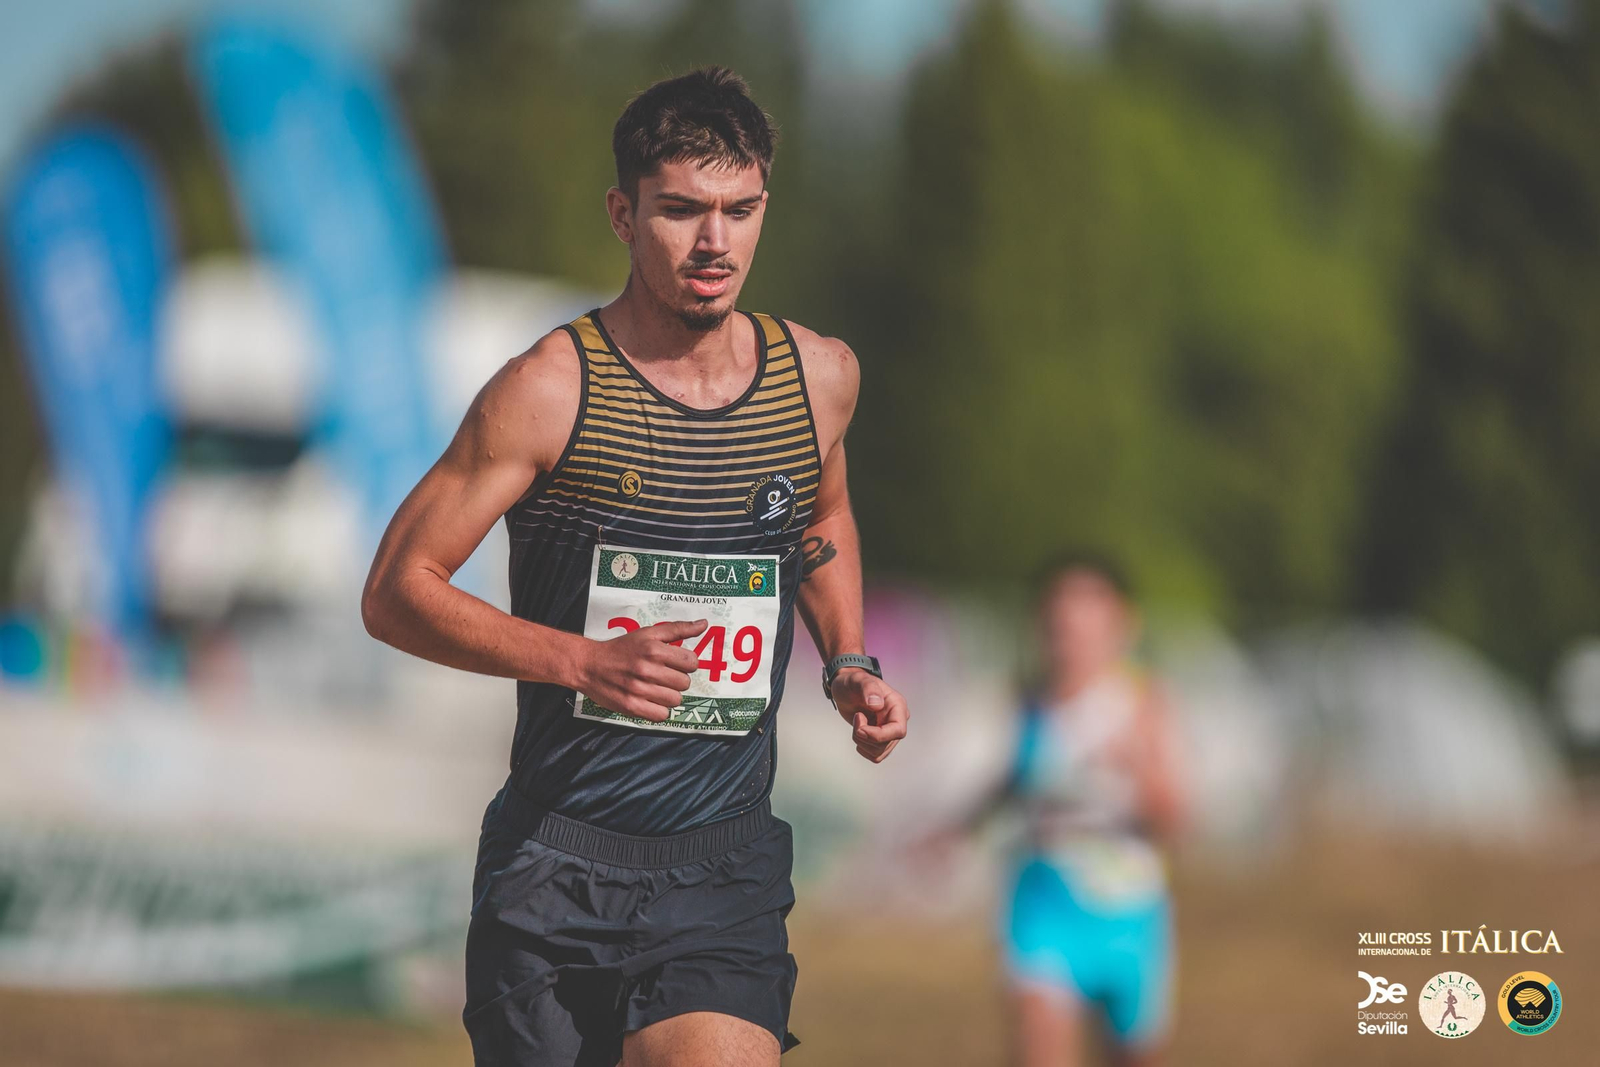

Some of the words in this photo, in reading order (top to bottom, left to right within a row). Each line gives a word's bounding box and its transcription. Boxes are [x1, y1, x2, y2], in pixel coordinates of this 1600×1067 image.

[746, 475, 772, 512] GRANADA
[773, 474, 795, 494] JOVEN
[651, 558, 739, 584] ITÁLICA
[660, 593, 700, 604] GRANADA
[701, 597, 728, 605] JOVEN
